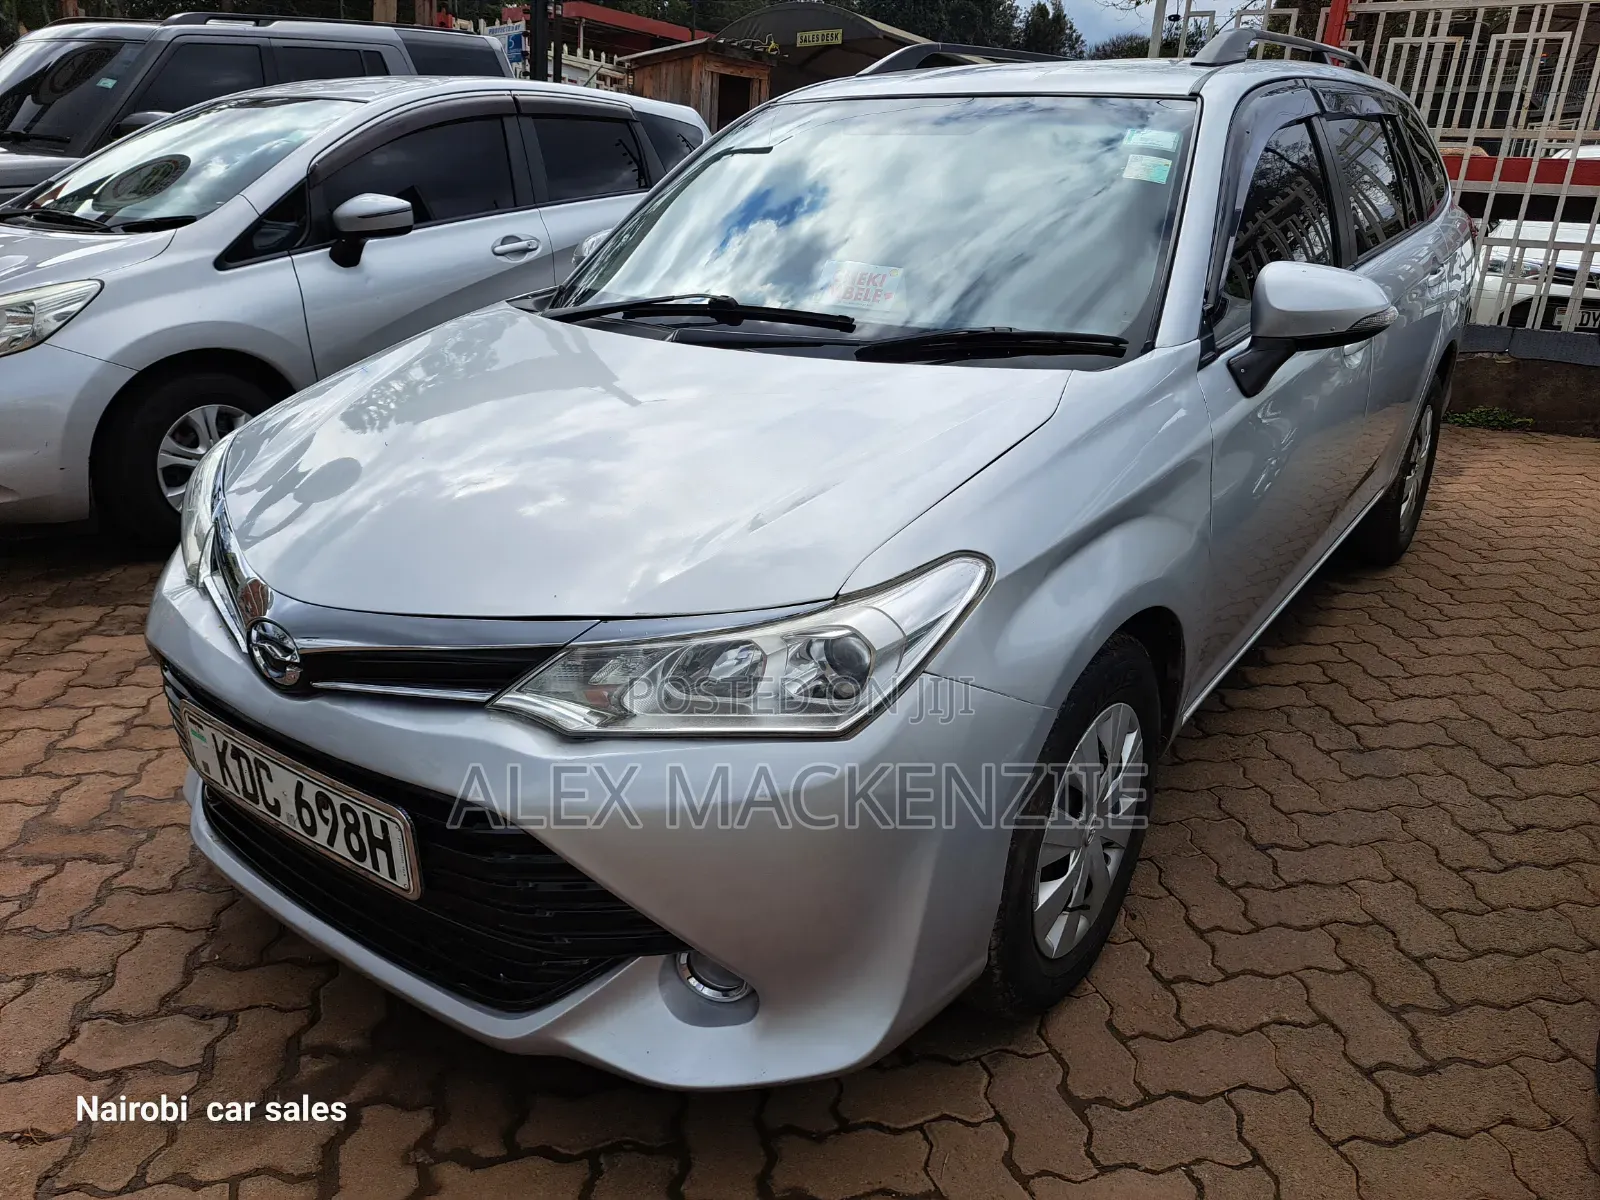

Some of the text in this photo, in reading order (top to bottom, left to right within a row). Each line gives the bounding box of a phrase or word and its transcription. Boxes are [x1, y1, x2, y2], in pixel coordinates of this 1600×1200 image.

[799, 32, 840, 43] SALES DESK
[211, 733, 281, 818] KDC
[294, 780, 397, 881] 698H
